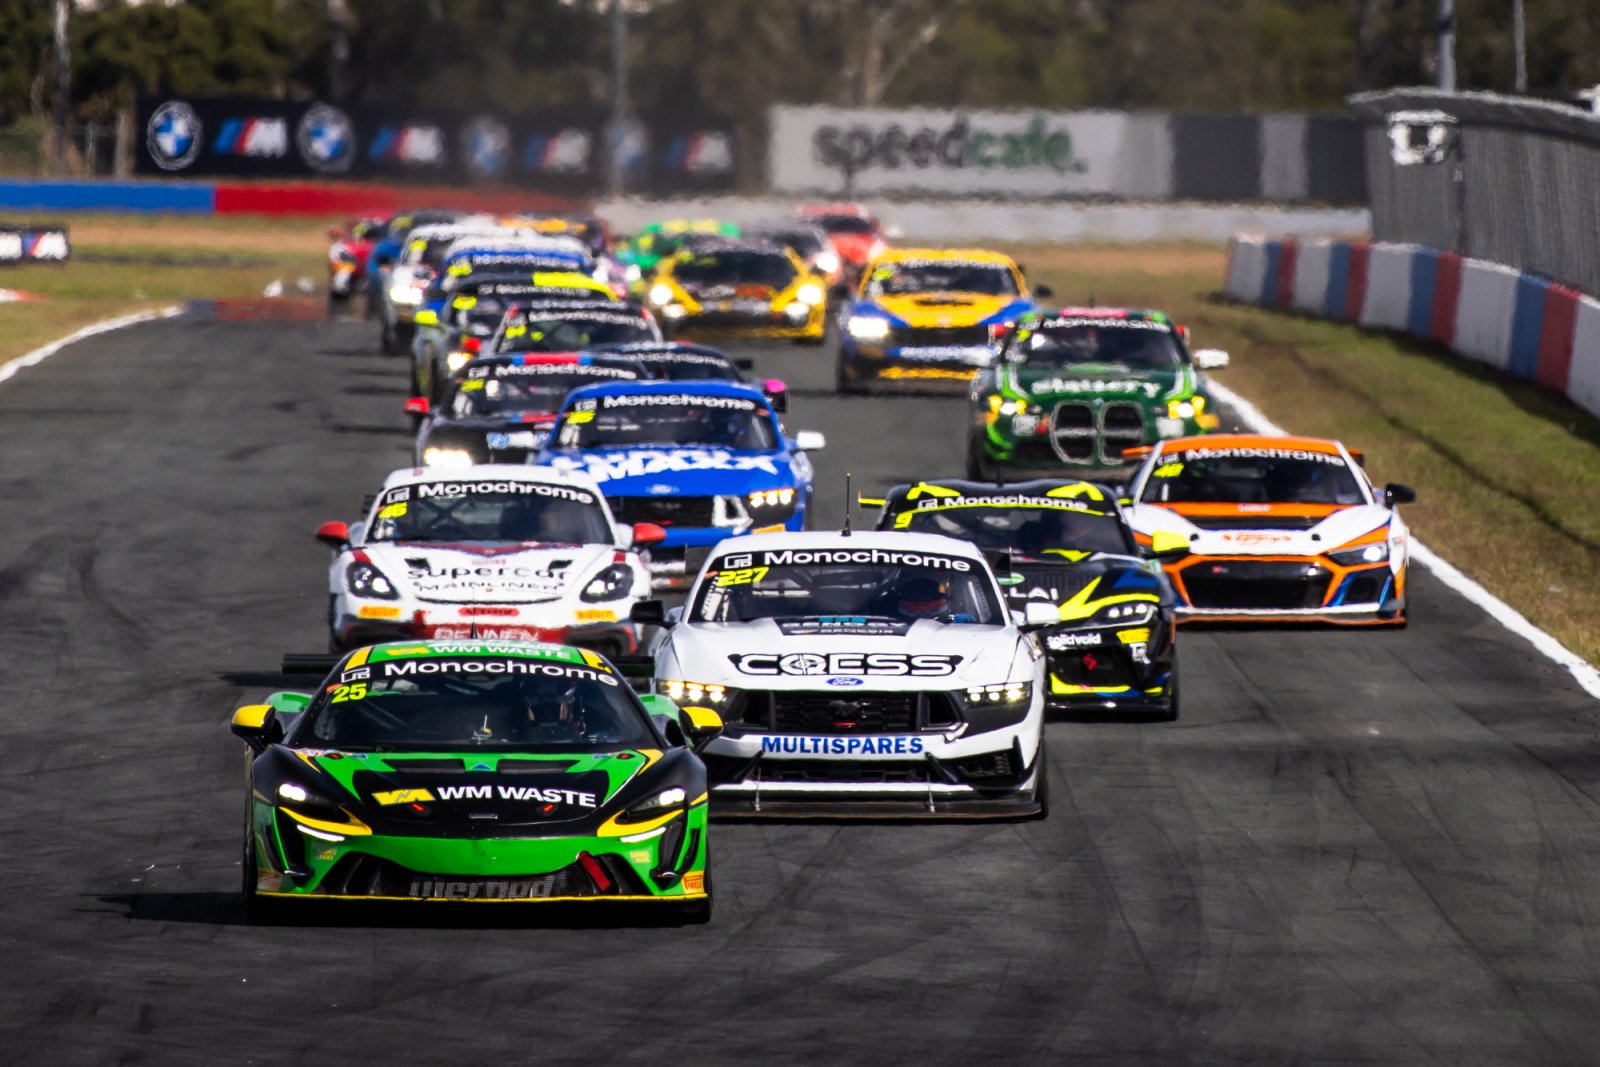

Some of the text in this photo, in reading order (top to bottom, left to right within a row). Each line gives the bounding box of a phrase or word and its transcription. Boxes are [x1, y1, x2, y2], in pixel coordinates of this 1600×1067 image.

[603, 394, 755, 411] Monochrome
[1185, 447, 1346, 467] Monochrome
[417, 481, 594, 505] Monochrome
[944, 494, 1089, 511] Monochrome
[764, 549, 972, 573] Monochrome
[717, 566, 770, 587] 227
[432, 645, 572, 659] WM WASTE
[384, 660, 619, 687] Monochrome
[331, 682, 368, 704] 25
[761, 736, 924, 755] MULTISPARES
[437, 785, 597, 808] WM WASTE
